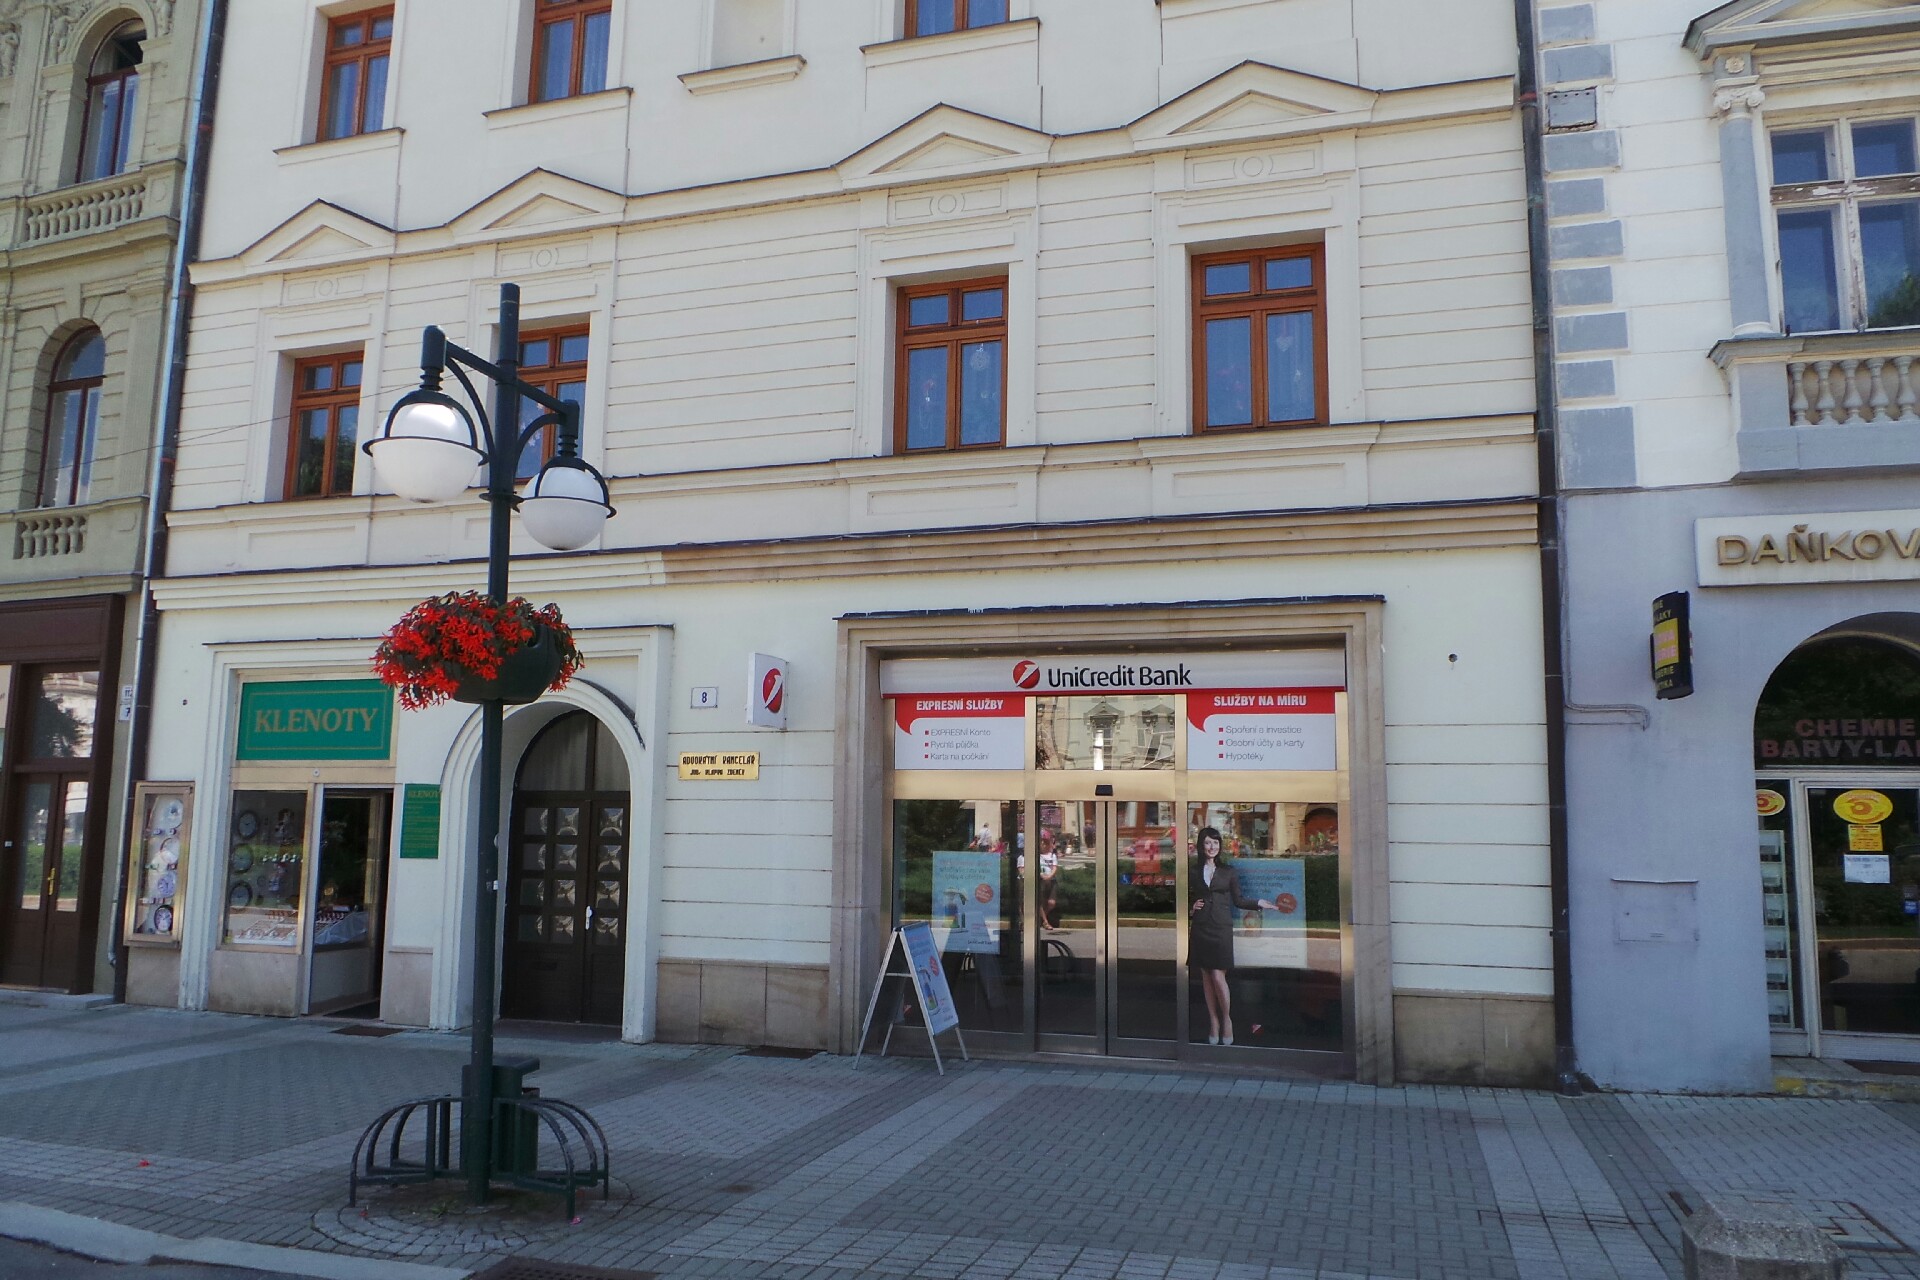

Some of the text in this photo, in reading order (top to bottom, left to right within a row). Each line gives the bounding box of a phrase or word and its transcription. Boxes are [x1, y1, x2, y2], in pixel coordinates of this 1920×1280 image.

[1717, 523, 1920, 566] DAŇKOV
[1048, 663, 1192, 687] UniCredit Bank
[701, 691, 707, 703] 8
[1214, 693, 1307, 707] SLUŽBY NA MÍRU
[916, 698, 1004, 711] EXPRESNÍ SLUŽBY
[255, 708, 378, 732] KLENOTY
[931, 728, 968, 736] EXPRESNÍ
[1225, 725, 1257, 735] Spoření
[1266, 726, 1302, 734] investice
[1795, 718, 1916, 737] CHEMIE
[1226, 738, 1255, 747] Osobní
[1257, 738, 1274, 748] účty
[1284, 738, 1305, 748] karty
[1761, 739, 1920, 758] BARVY-LA
[930, 752, 949, 761] Karta
[1226, 752, 1264, 762] Hypotéky
